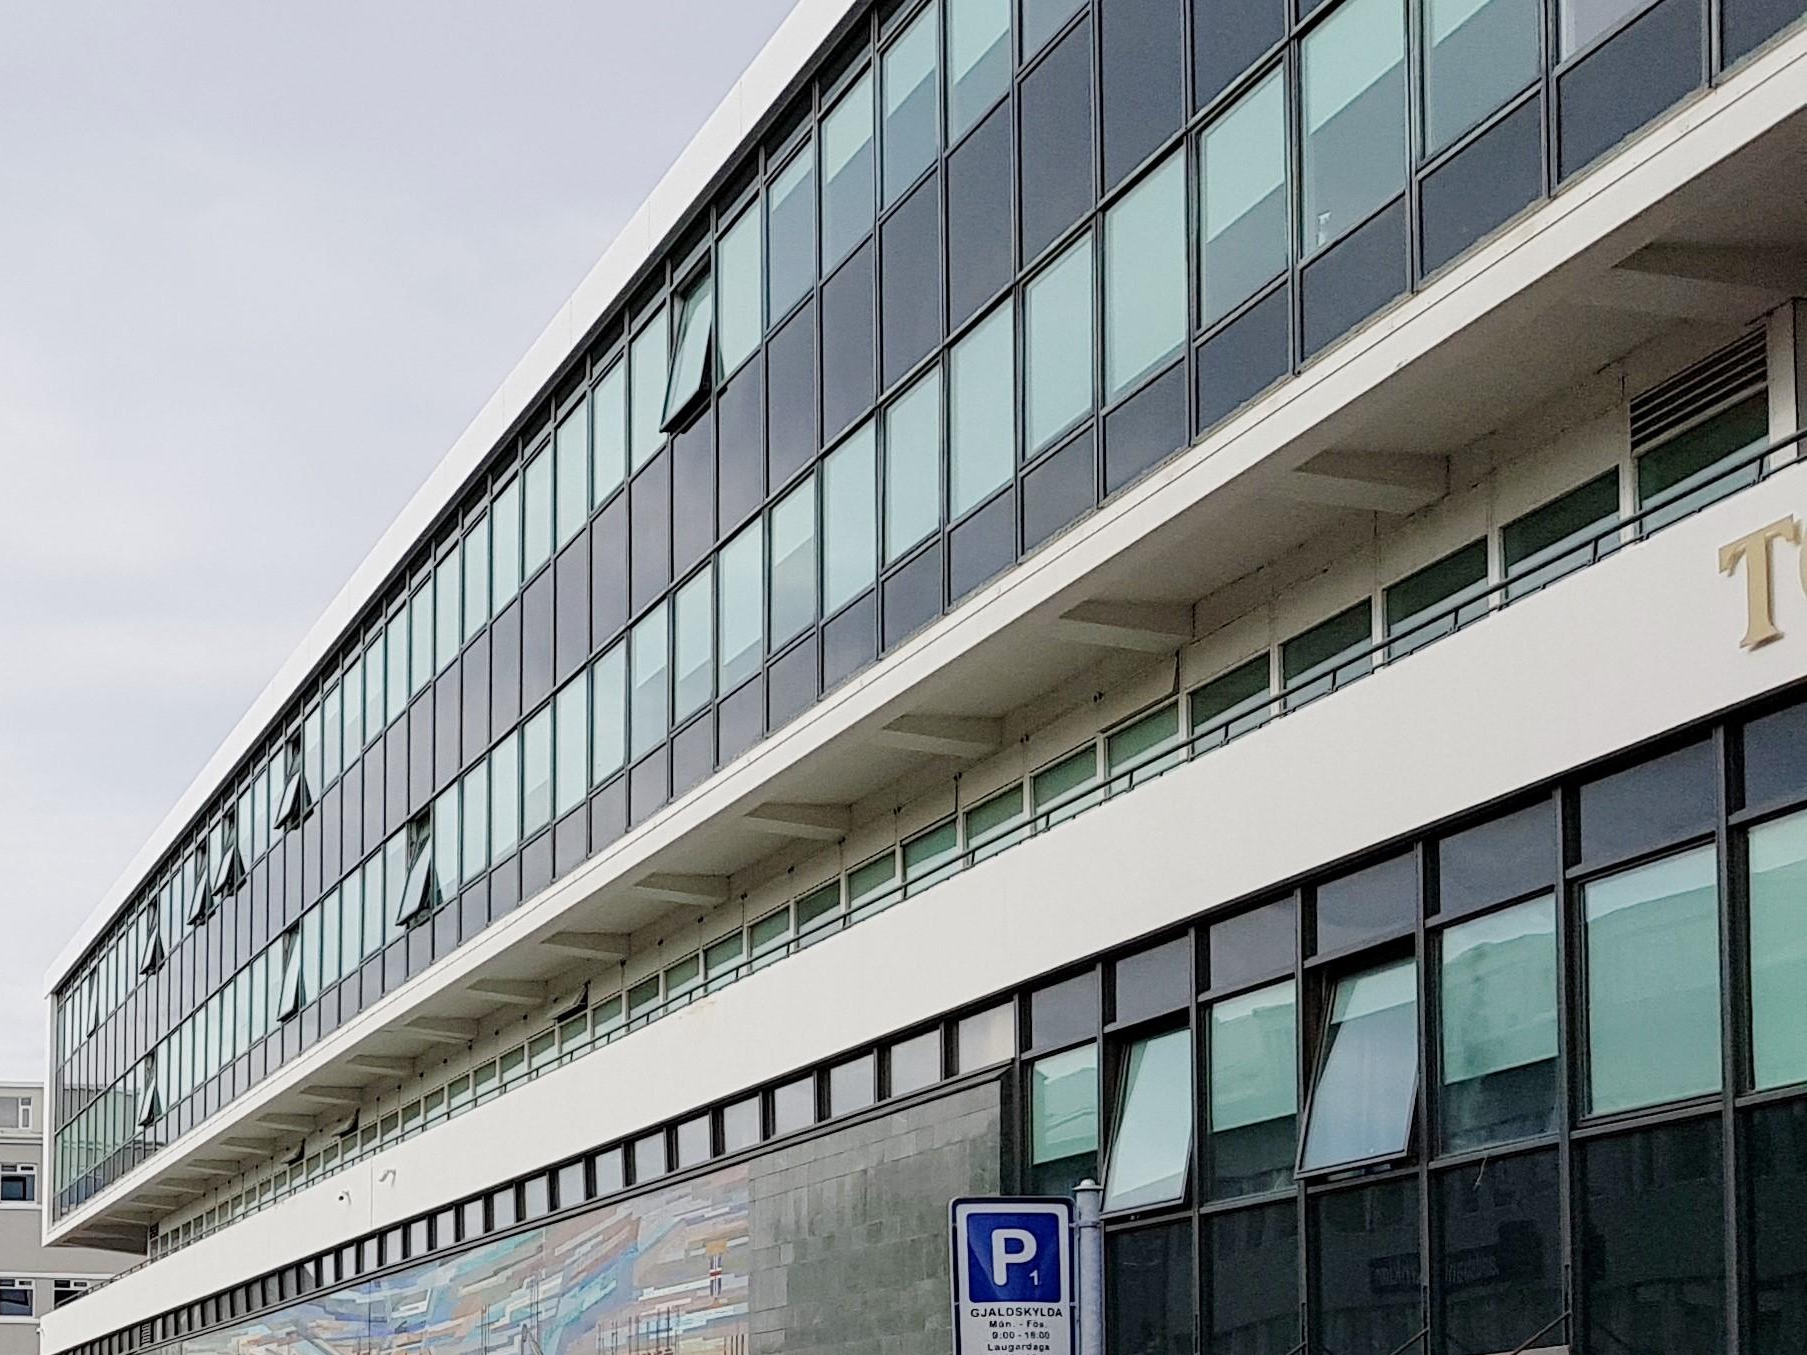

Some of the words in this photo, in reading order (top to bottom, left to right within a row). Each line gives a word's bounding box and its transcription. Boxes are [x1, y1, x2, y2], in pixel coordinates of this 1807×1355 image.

[1718, 513, 1807, 653] T
[992, 1228, 1037, 1287] P
[1029, 1269, 1039, 1286] 1
[970, 1307, 1063, 1318] GJALDSKYLDA
[987, 1343, 1050, 1352] Laugardaga
